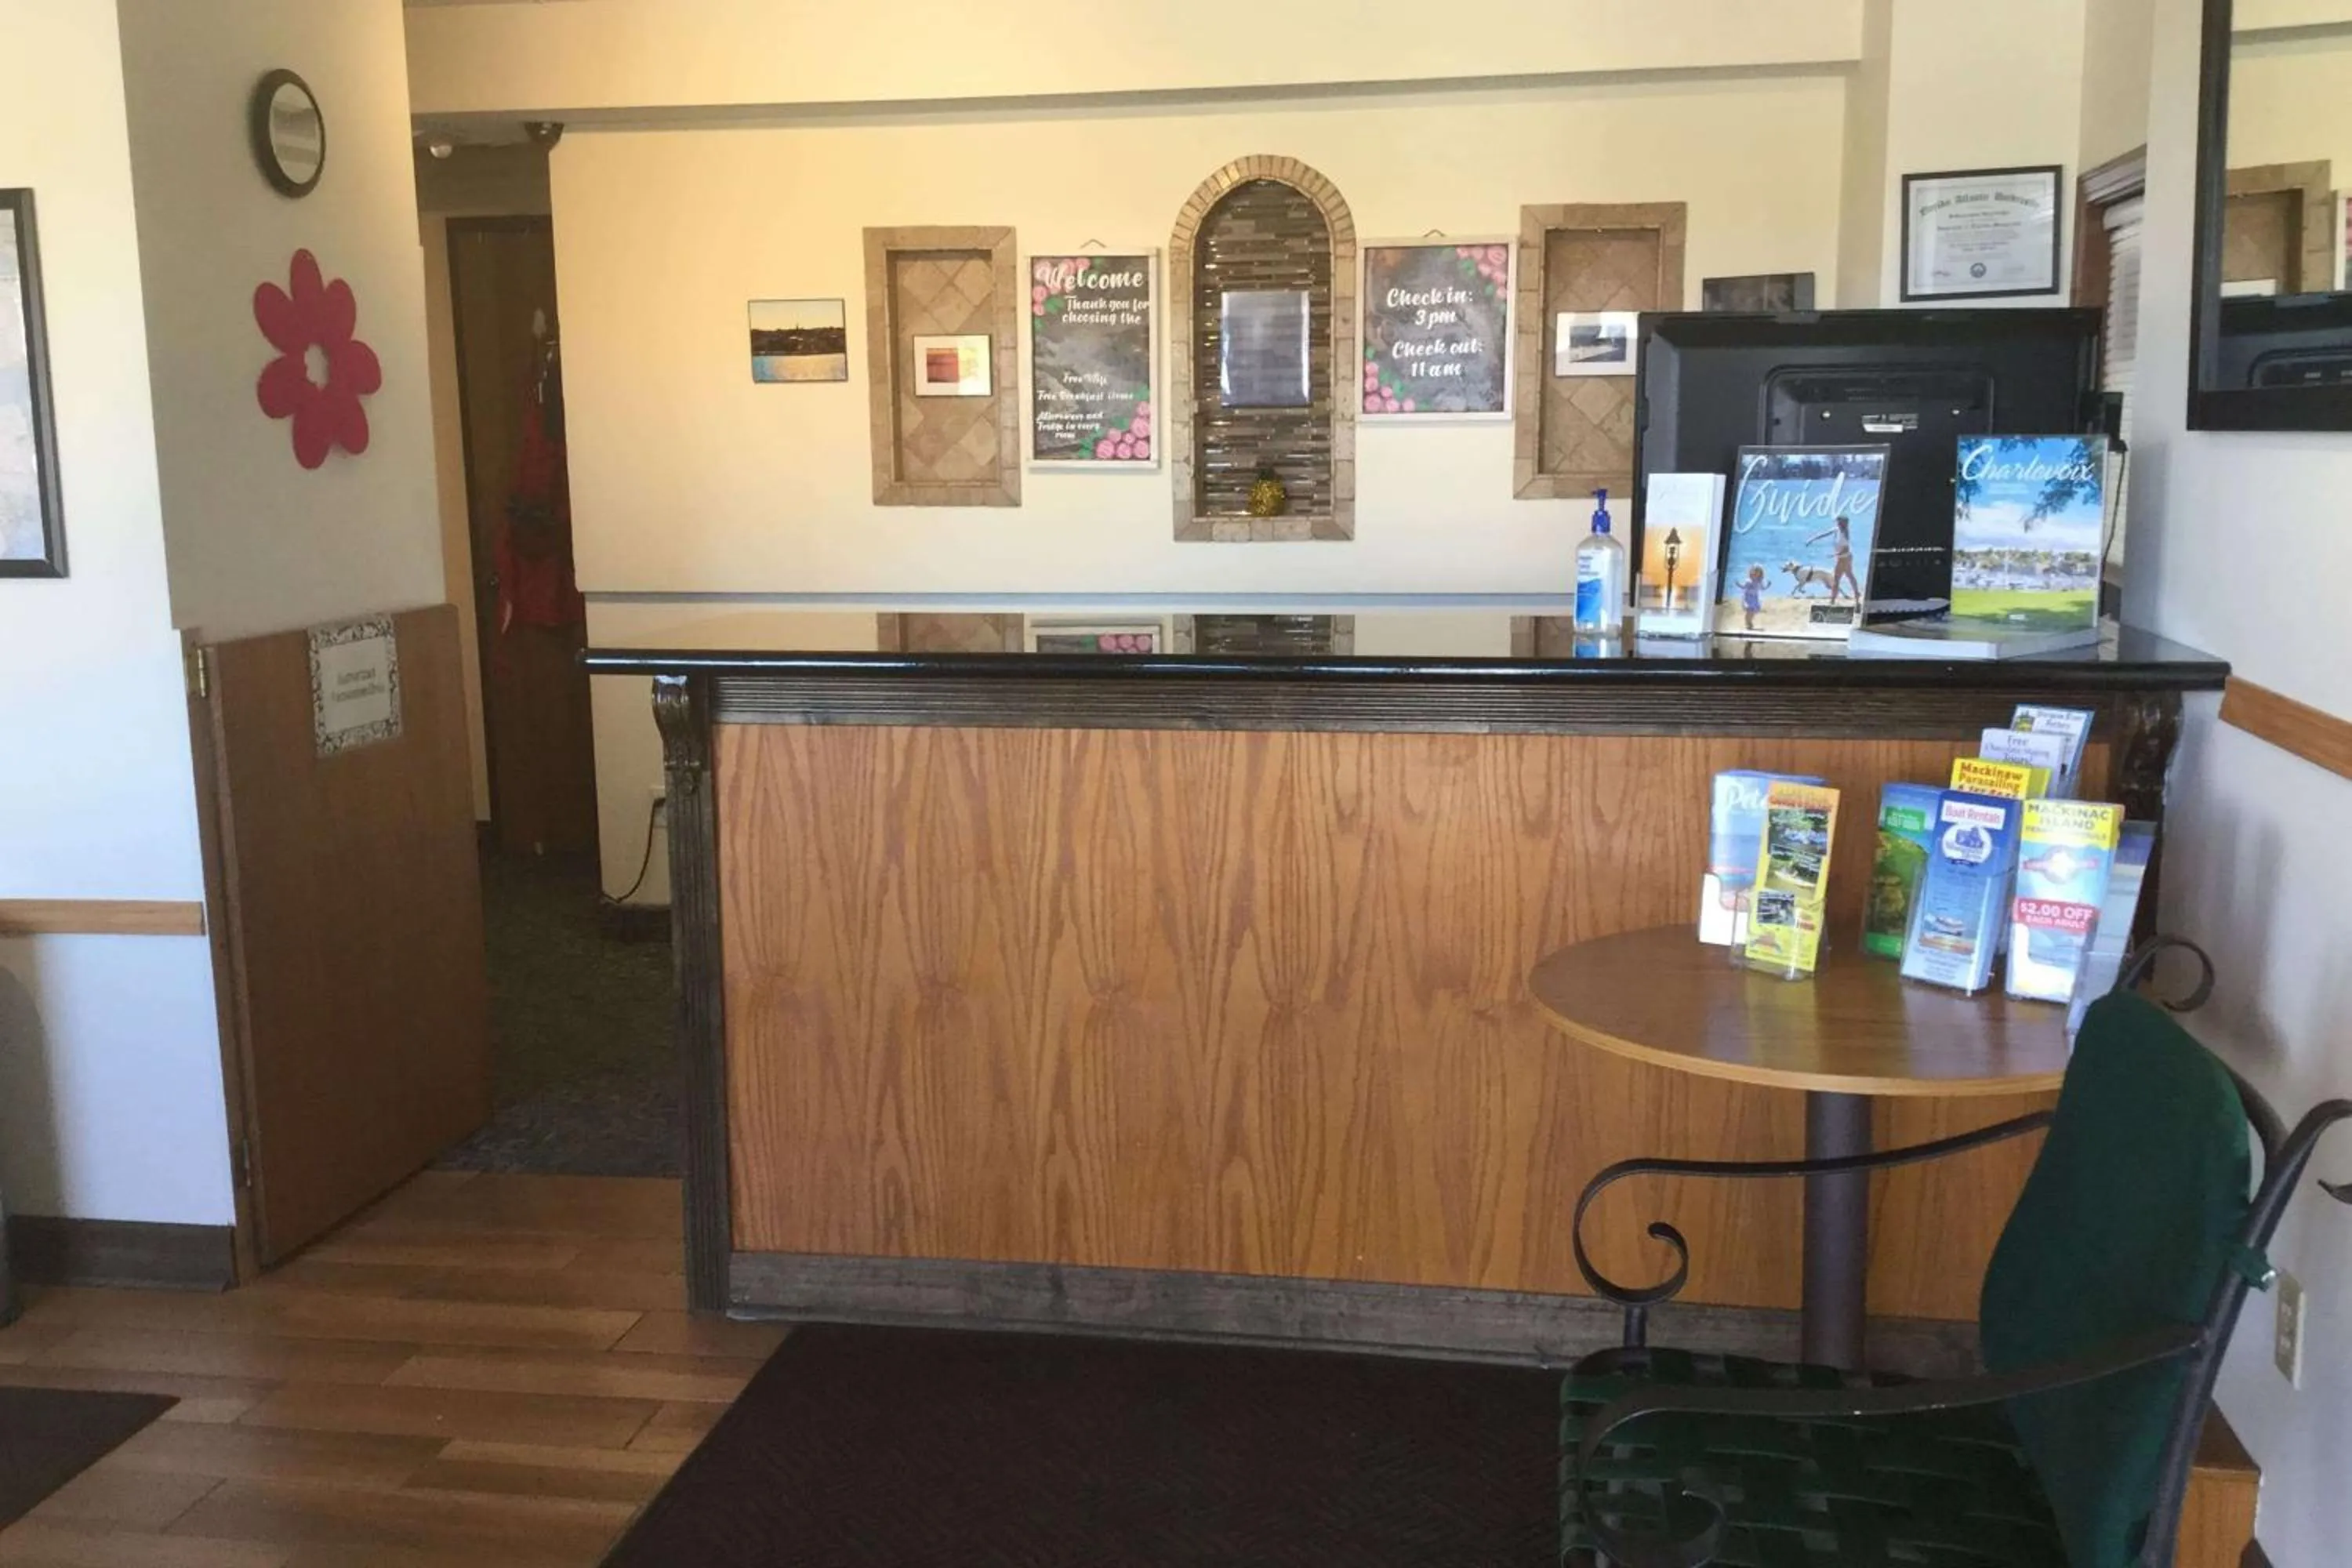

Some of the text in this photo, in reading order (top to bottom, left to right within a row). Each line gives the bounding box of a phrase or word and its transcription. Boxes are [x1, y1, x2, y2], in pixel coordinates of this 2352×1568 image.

[1034, 263, 1143, 290] Welcome
[1065, 295, 1151, 313] Thank you for
[1386, 286, 1473, 308] Check in:
[1062, 311, 1142, 326] choosing the
[1392, 338, 1484, 360] Check out:
[1063, 372, 1083, 383] Free
[1036, 389, 1057, 401] Free
[1962, 445, 2096, 481] Charlevoix
[1734, 455, 1878, 534] Guide
[1961, 761, 2024, 781] Mackinaw
[1958, 771, 2020, 793] Parasailing
[1945, 805, 2001, 824] Boat Rentals
[2027, 804, 2110, 821] MACKINAC
[2039, 816, 2096, 831] ISLAND
[2020, 902, 2094, 920] $2.00 OFF
[2025, 914, 2053, 926] EACH
